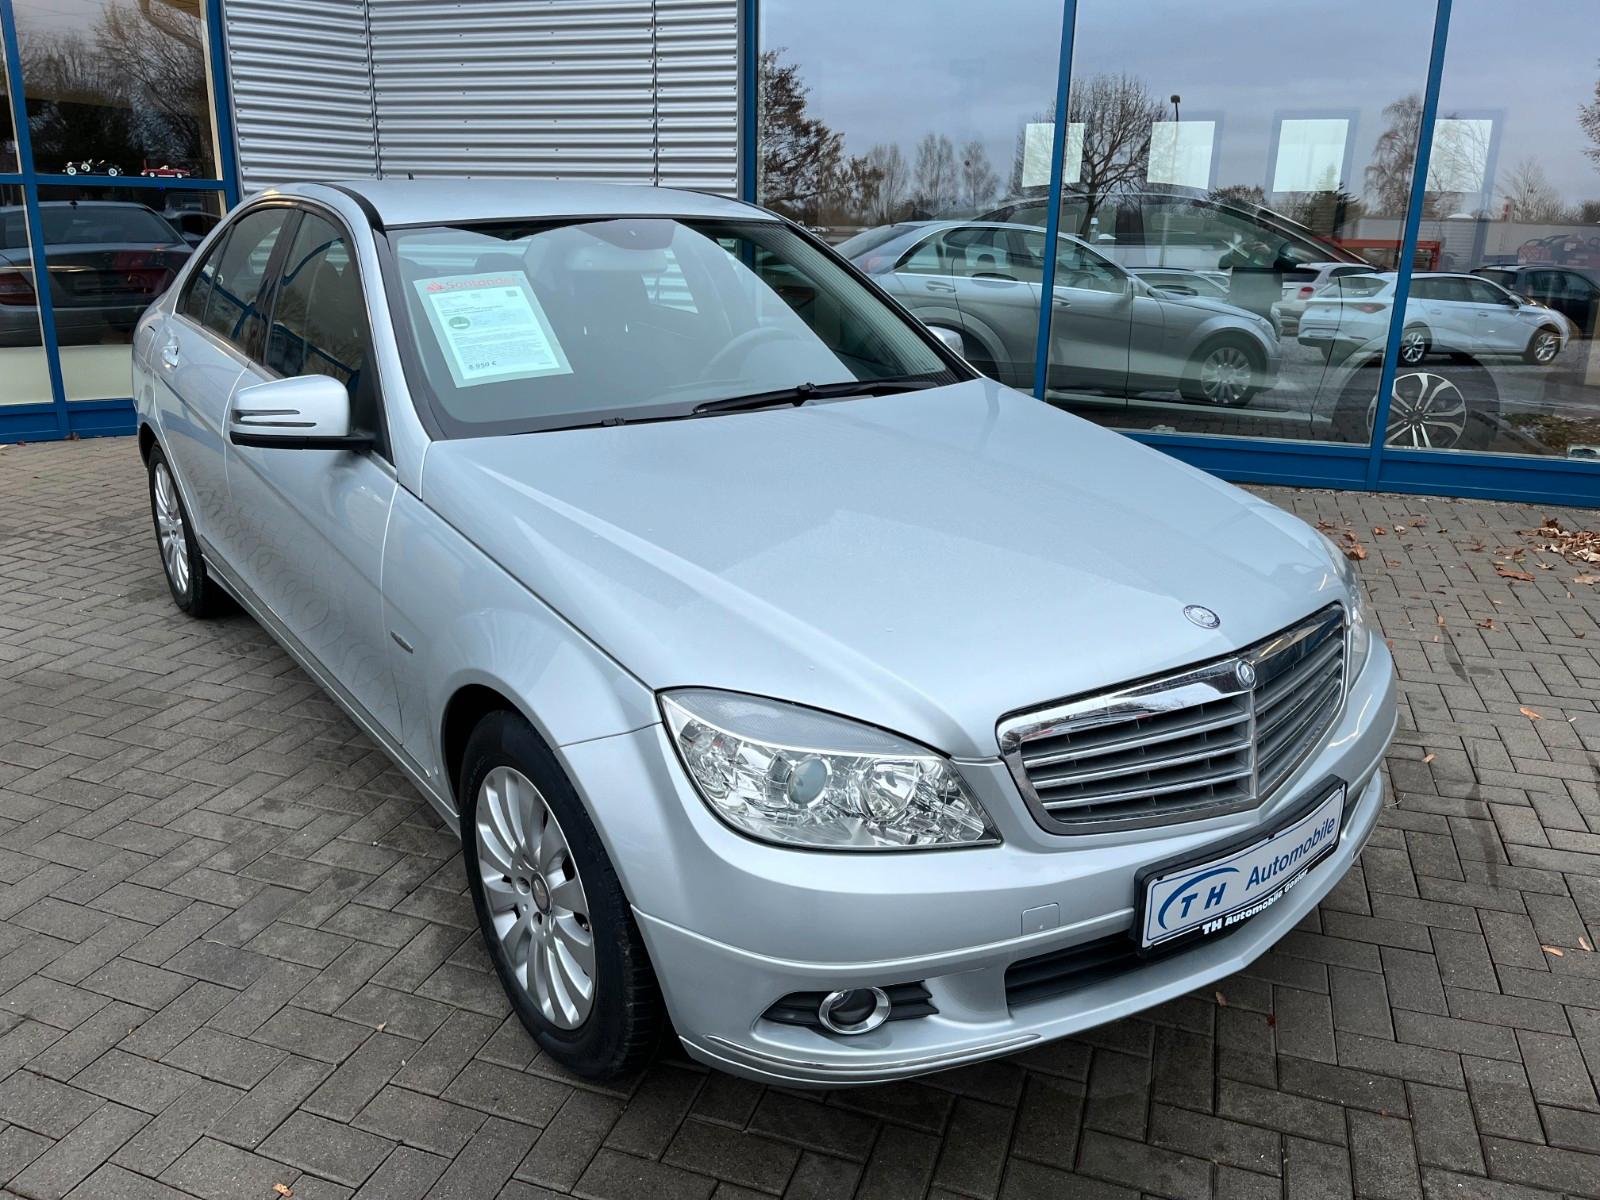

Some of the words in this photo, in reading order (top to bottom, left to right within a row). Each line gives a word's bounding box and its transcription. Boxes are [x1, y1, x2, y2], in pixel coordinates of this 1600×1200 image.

[1245, 817, 1335, 891] Automobile
[1202, 920, 1223, 935] TH
[1225, 890, 1283, 927] Automobile
